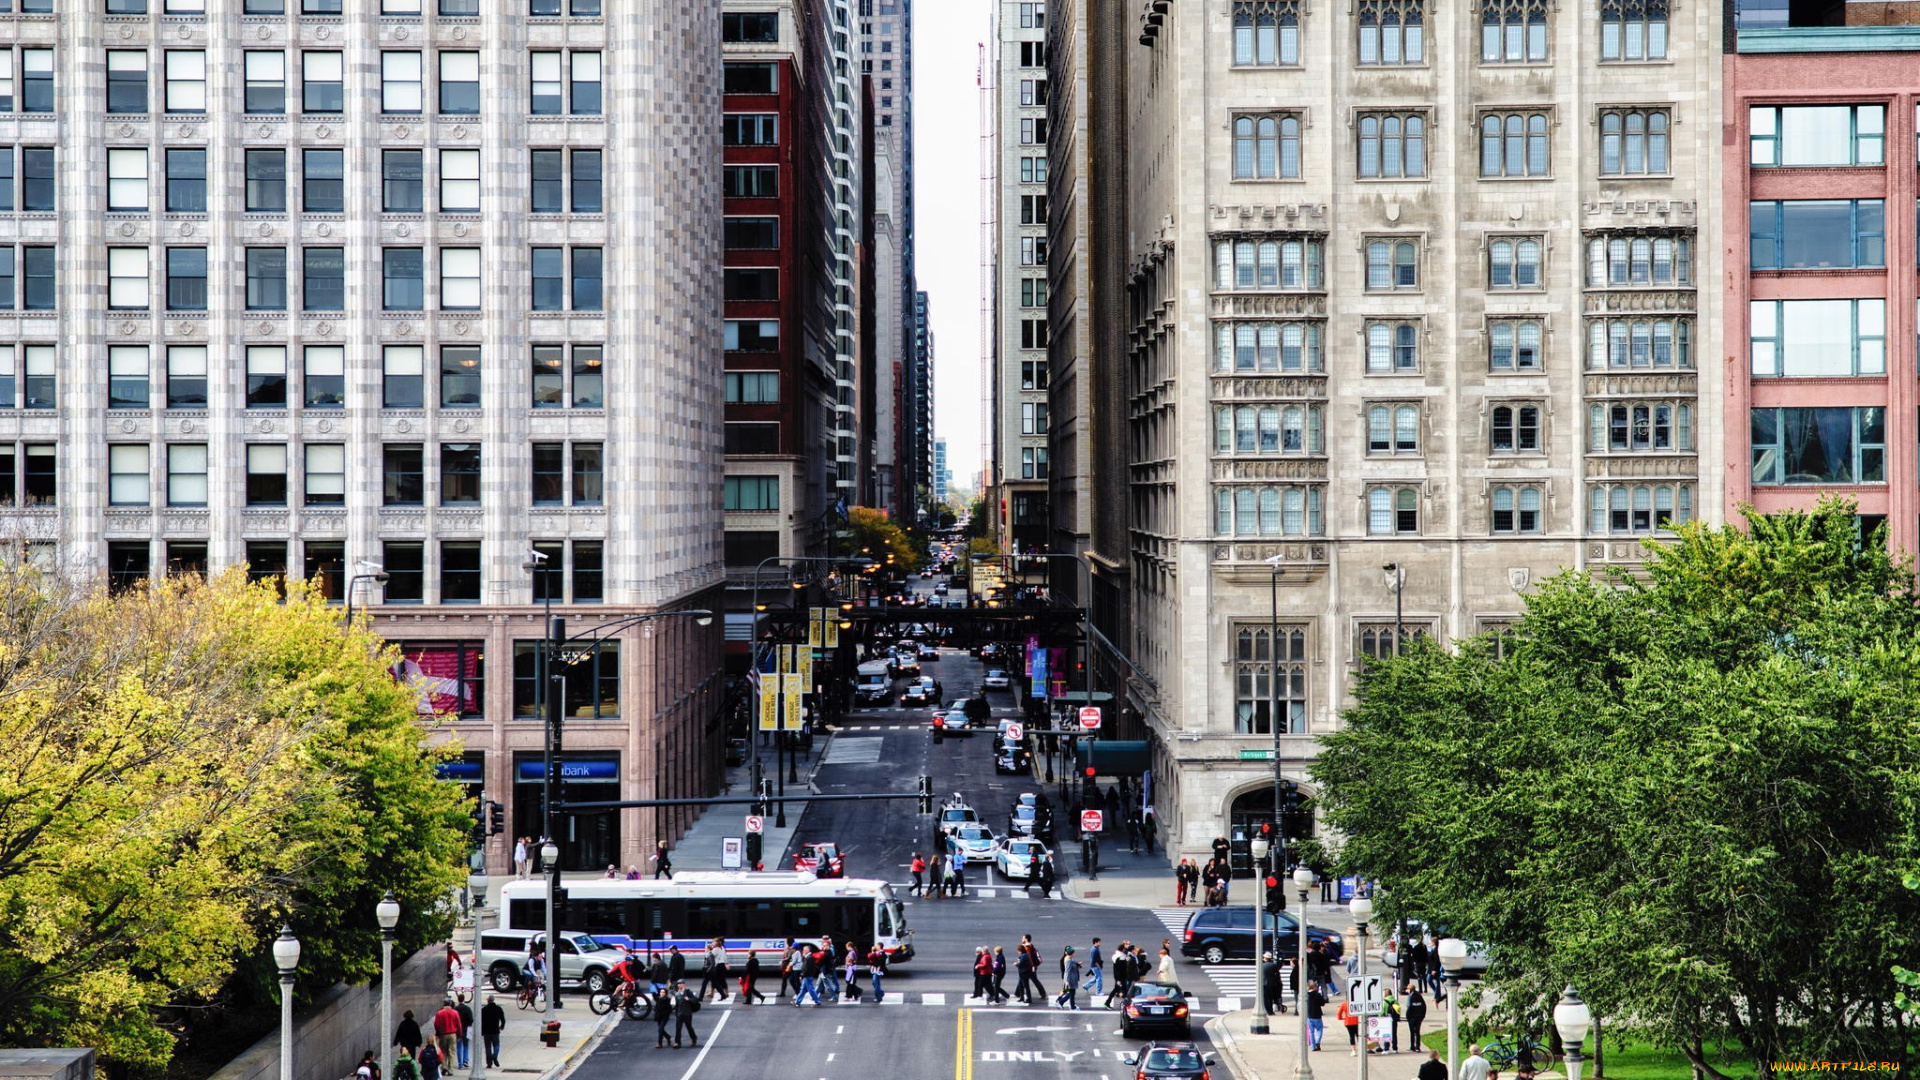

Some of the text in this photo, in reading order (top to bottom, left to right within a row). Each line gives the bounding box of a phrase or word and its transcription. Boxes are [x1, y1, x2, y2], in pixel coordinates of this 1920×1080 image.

[1350, 1003, 1363, 1013] ONLY
[1367, 1002, 1380, 1011] ONLY
[981, 1051, 1084, 1062] ONLY
